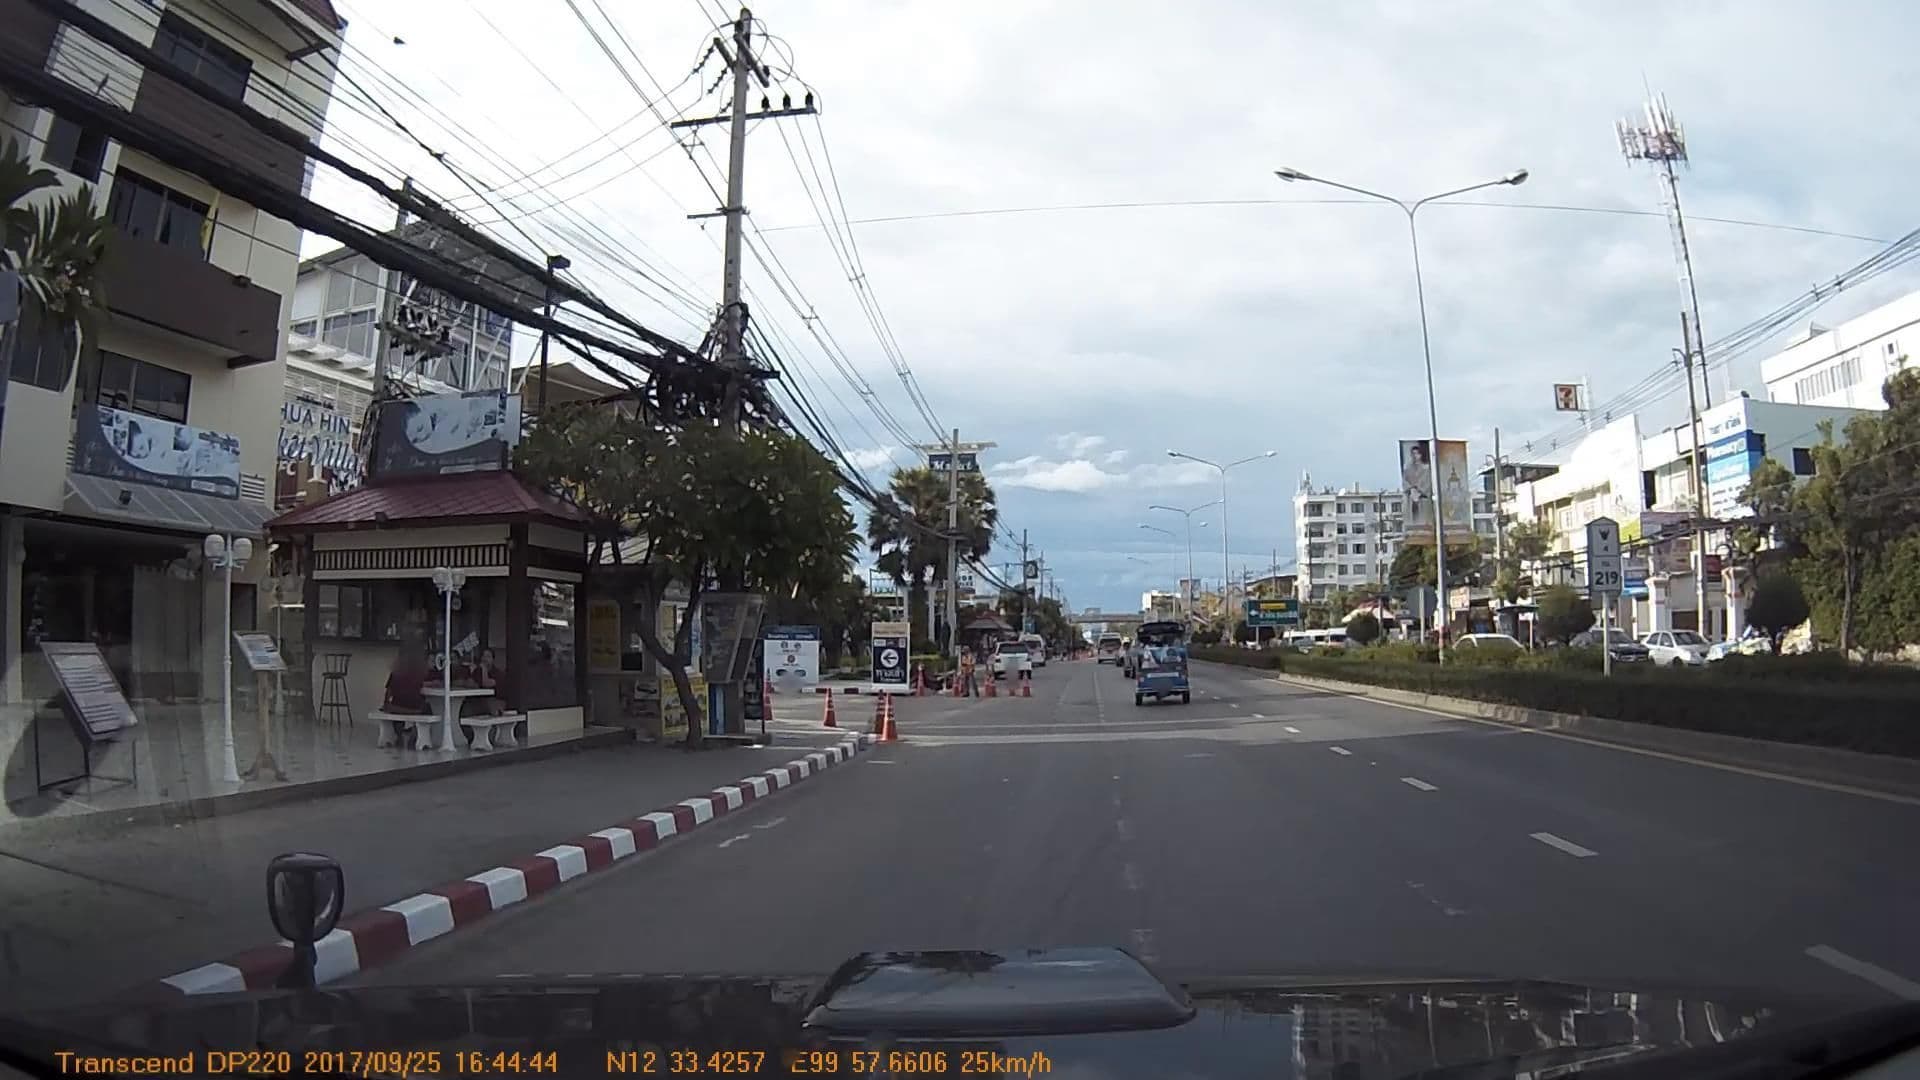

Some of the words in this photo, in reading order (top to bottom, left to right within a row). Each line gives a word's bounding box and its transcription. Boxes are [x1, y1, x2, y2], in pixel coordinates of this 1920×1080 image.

[281, 402, 313, 427] HUA
[320, 412, 350, 435] HIN
[1595, 571, 1618, 585] 219
